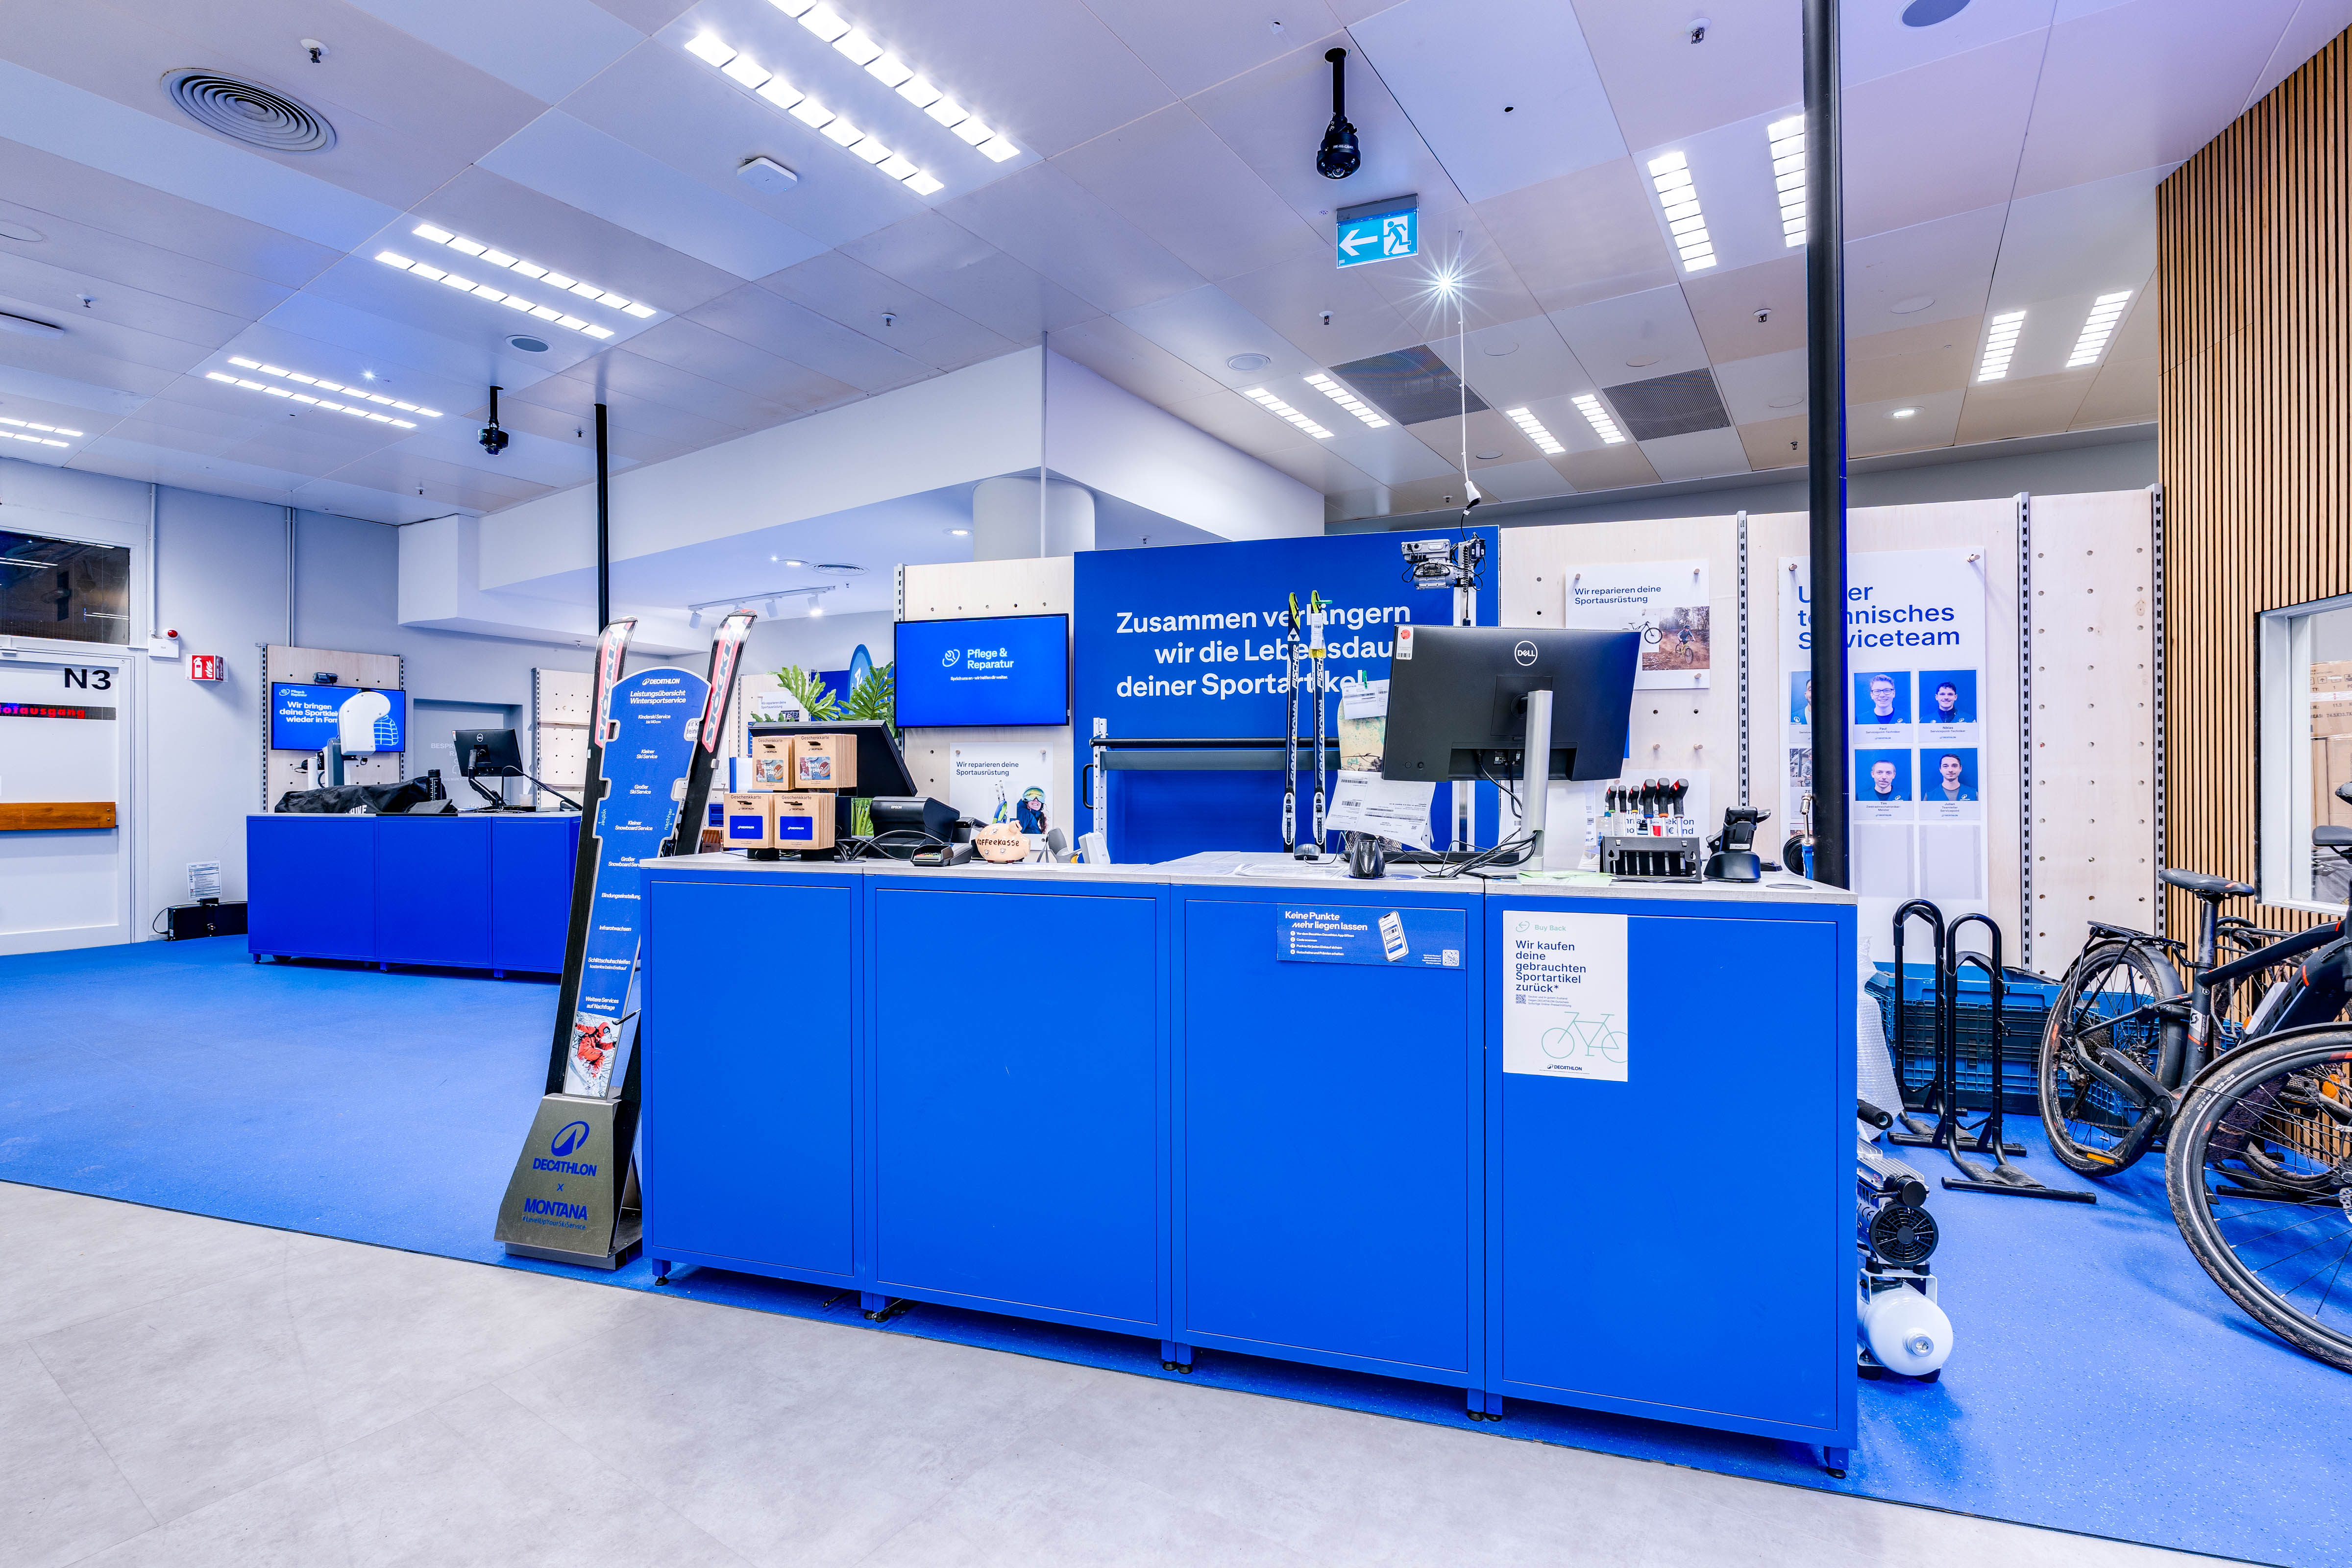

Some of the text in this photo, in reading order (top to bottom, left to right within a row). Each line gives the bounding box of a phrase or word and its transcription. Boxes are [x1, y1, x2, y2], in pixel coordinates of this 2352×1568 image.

[1591, 587, 1635, 596] reparieren
[1798, 586, 1873, 603] Uer
[1575, 595, 1648, 605] Sportausrüstung
[1116, 612, 1257, 633] Zusammen
[1798, 629, 1960, 650] Sviceteam
[968, 647, 1007, 660] Pflege &
[1154, 636, 1393, 663] wir die Lebesdau
[968, 660, 1014, 670] Reparatur
[64, 668, 111, 690] N3
[1116, 675, 1196, 697] deiner
[304, 702, 332, 710] bringen
[664, 808, 673, 830] nachher
[1309, 912, 1340, 920] Punkte
[1315, 921, 1340, 931] liegen
[1341, 922, 1368, 931] lassen
[1516, 940, 1575, 951] Wir kaufen
[1516, 951, 1545, 960] deine
[1516, 962, 1586, 973] gebrauchten
[1516, 972, 1581, 983] Sportartikel
[532, 1157, 597, 1176] DECATHLON
[524, 1198, 588, 1221] MONTANA
[522, 1215, 586, 1230] #LevelUpYourSkiService
